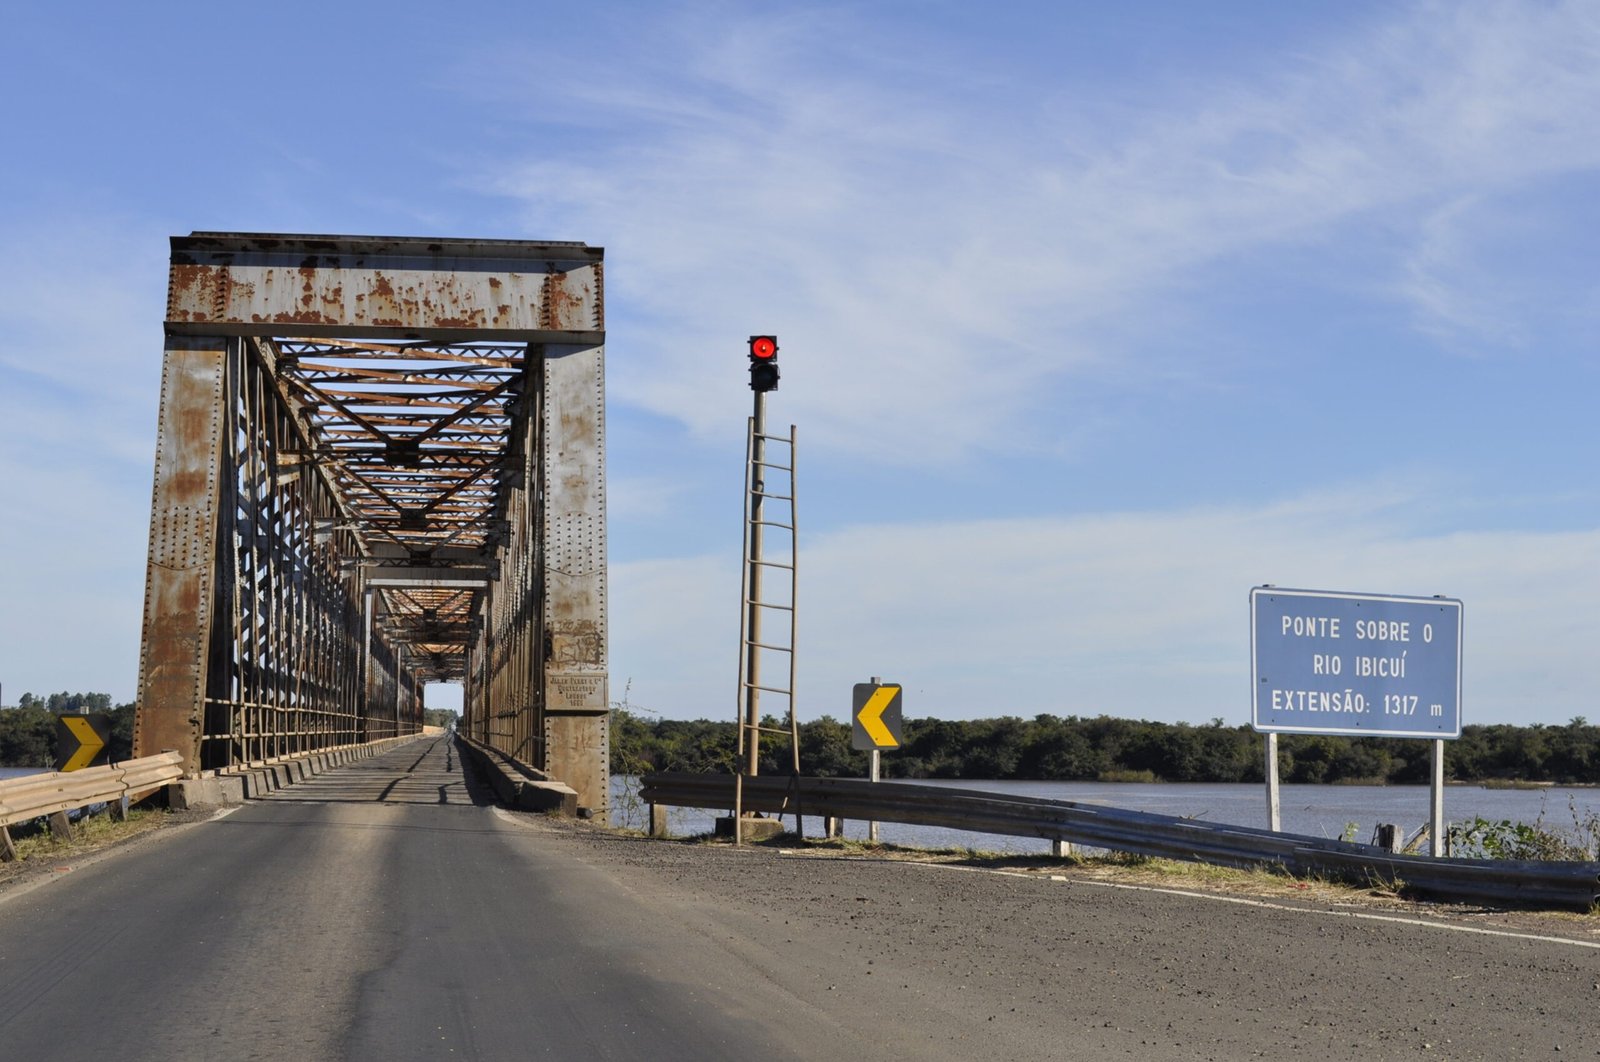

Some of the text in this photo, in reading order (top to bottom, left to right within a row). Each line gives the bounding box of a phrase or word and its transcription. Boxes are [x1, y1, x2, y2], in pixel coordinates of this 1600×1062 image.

[1282, 615, 1433, 643] PONTE SOBRE O
[1313, 650, 1408, 678] RIO IBICUÍ
[1272, 688, 1442, 717] EXTENSÃO: 1317 m
